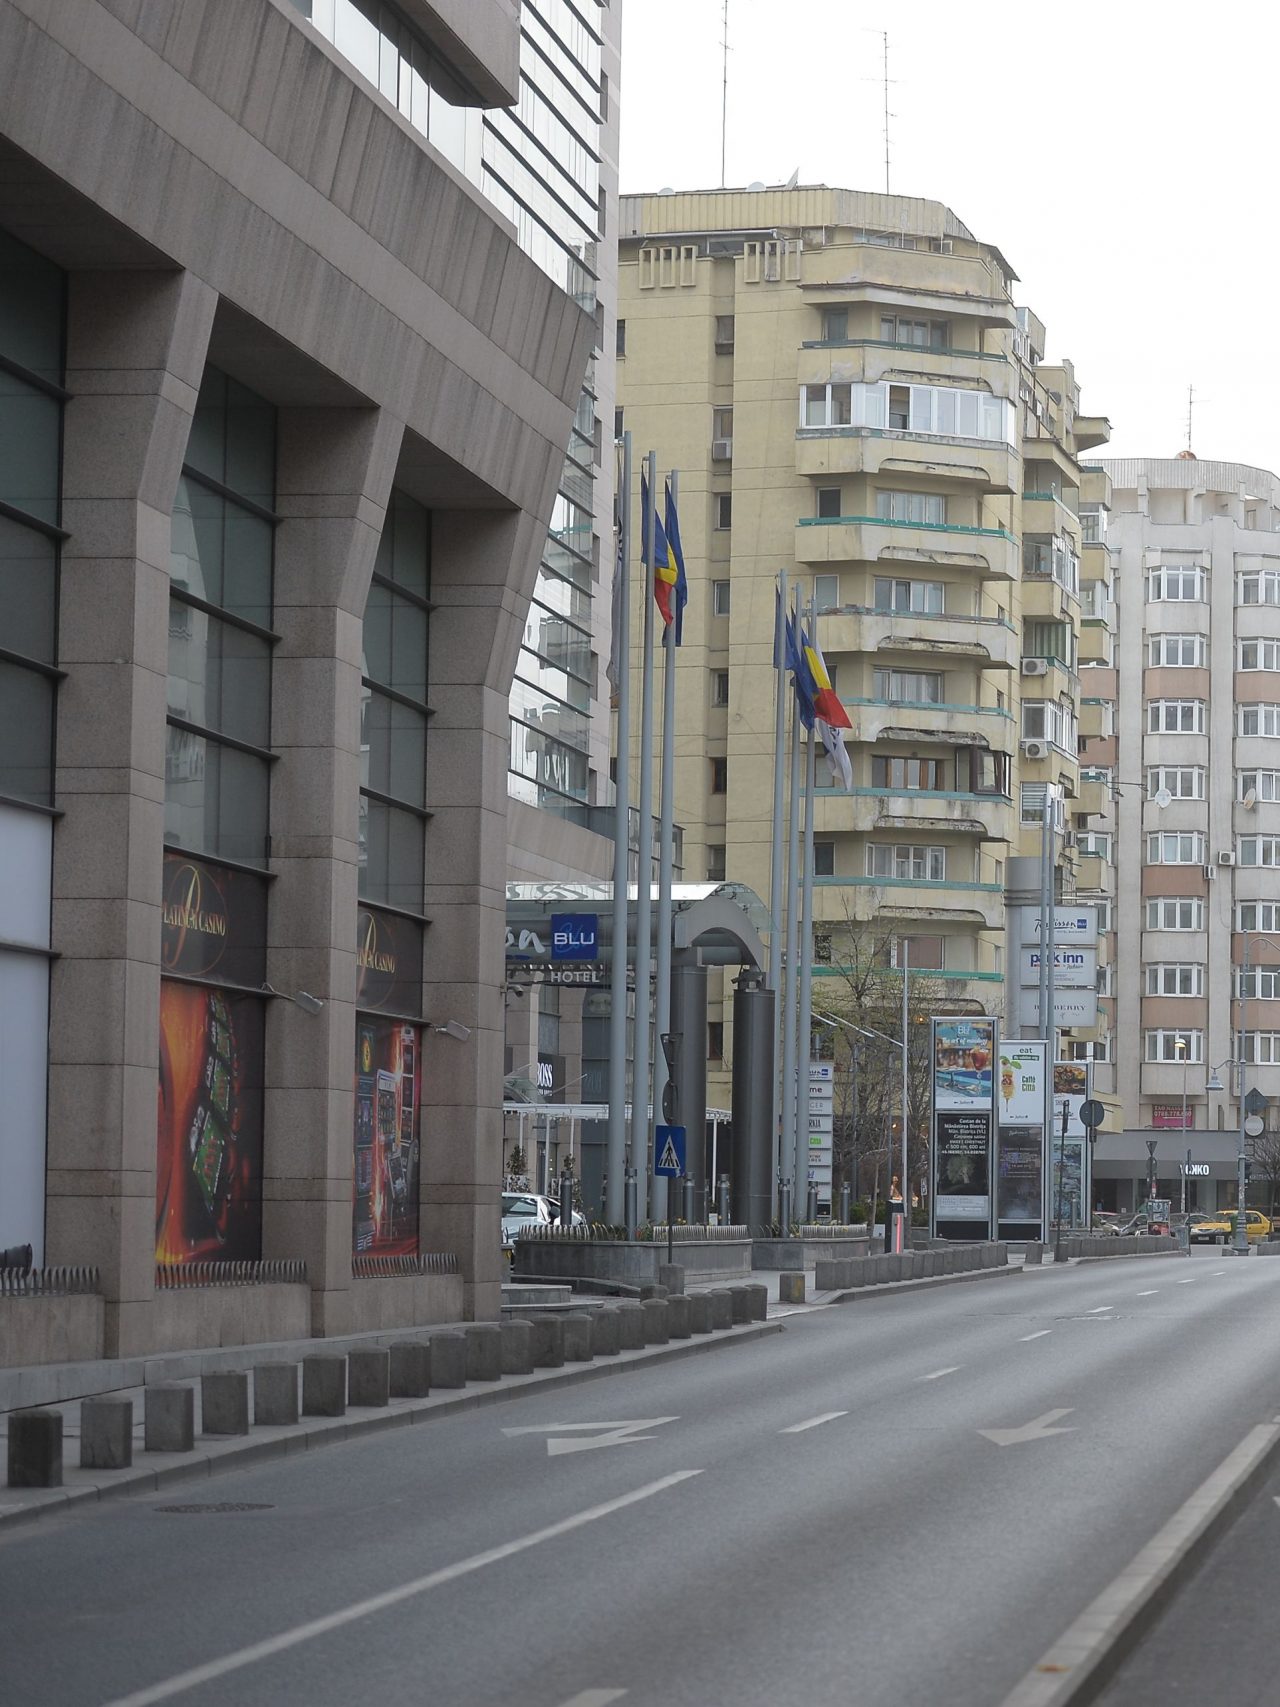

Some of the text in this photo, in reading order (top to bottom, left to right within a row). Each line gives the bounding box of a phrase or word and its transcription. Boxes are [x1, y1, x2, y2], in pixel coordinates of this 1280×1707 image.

[198, 910, 226, 936] CASINO
[554, 932, 595, 945] BLU
[1063, 952, 1084, 963] inn
[551, 971, 601, 983] HOTEL
